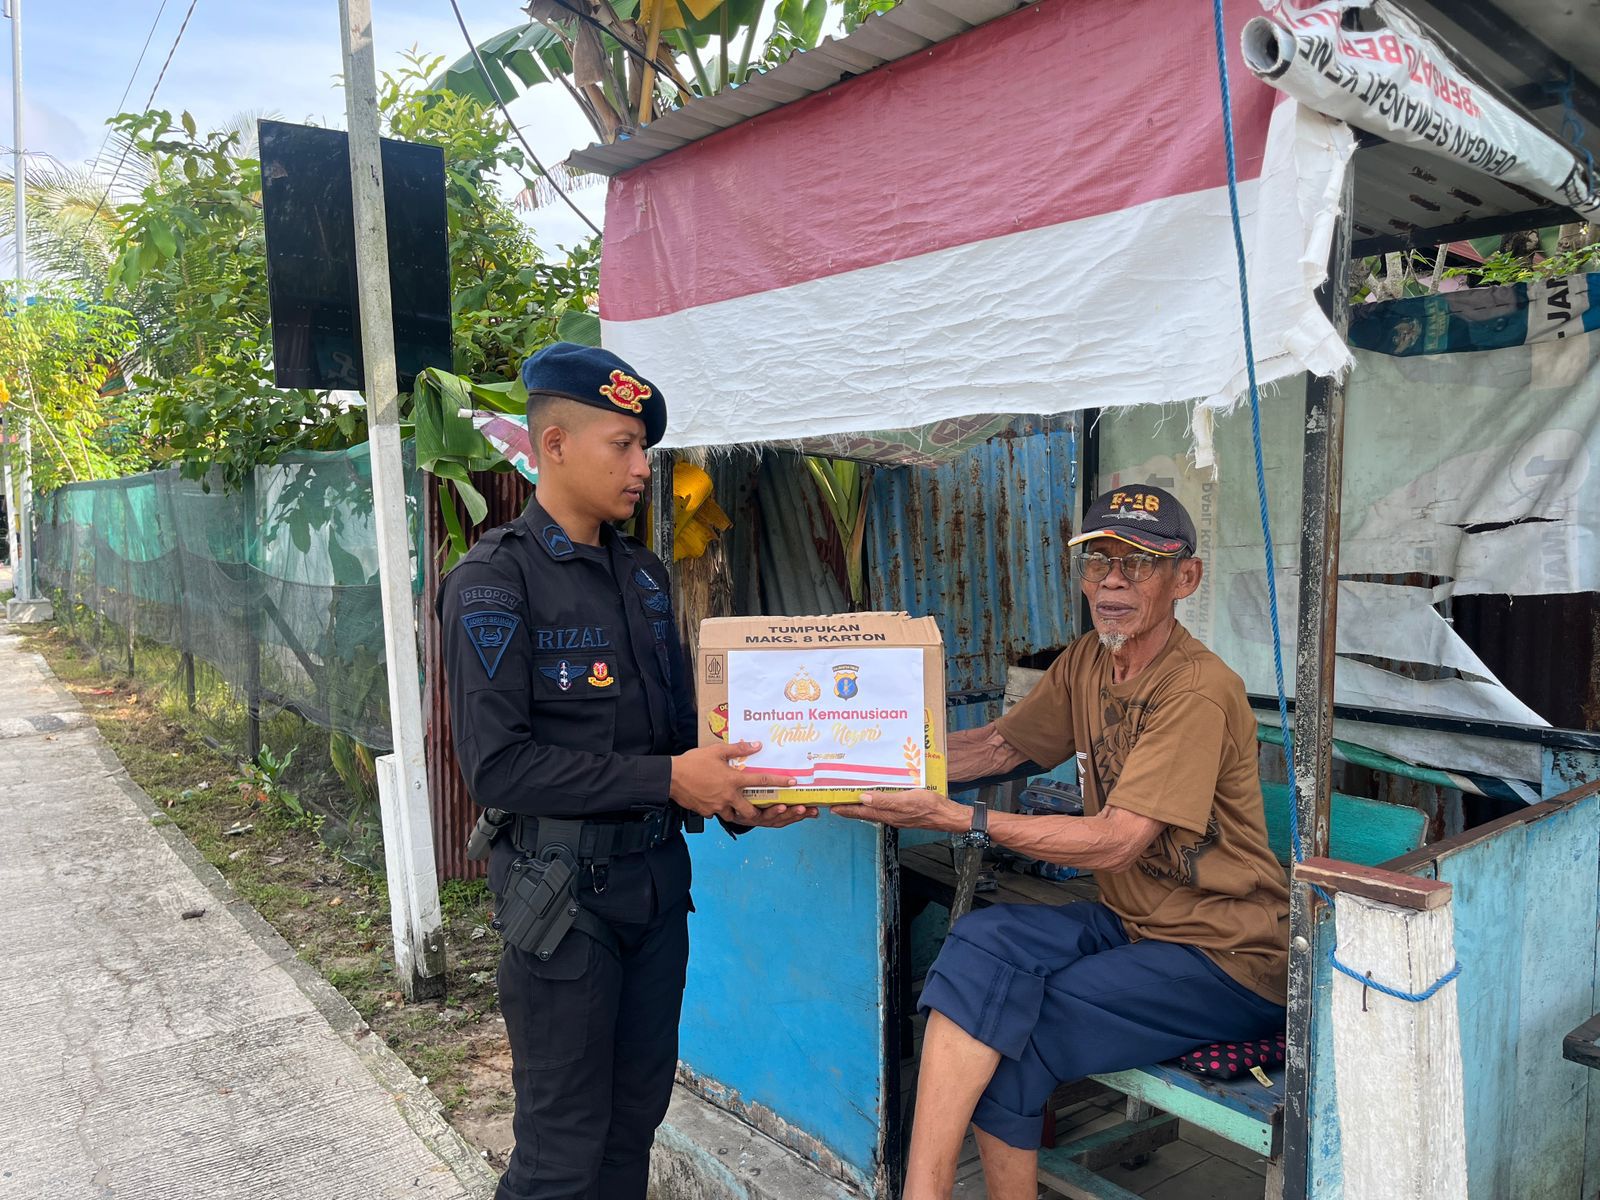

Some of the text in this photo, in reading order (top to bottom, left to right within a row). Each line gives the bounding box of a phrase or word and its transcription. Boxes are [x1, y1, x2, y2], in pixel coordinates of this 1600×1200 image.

[1359, 72, 1453, 147] SEMANGAT
[1449, 124, 1517, 177] DENGAN
[1110, 492, 1160, 512] F-16
[464, 589, 517, 606] PELOPOR
[537, 626, 610, 650] RIZAL
[745, 635, 797, 644] MAKS.
[818, 633, 886, 642] KARTON
[768, 624, 860, 634] TUMPUKAN
[743, 707, 908, 721] Bantuan Kemanusiaan
[769, 722, 821, 747] Untuk
